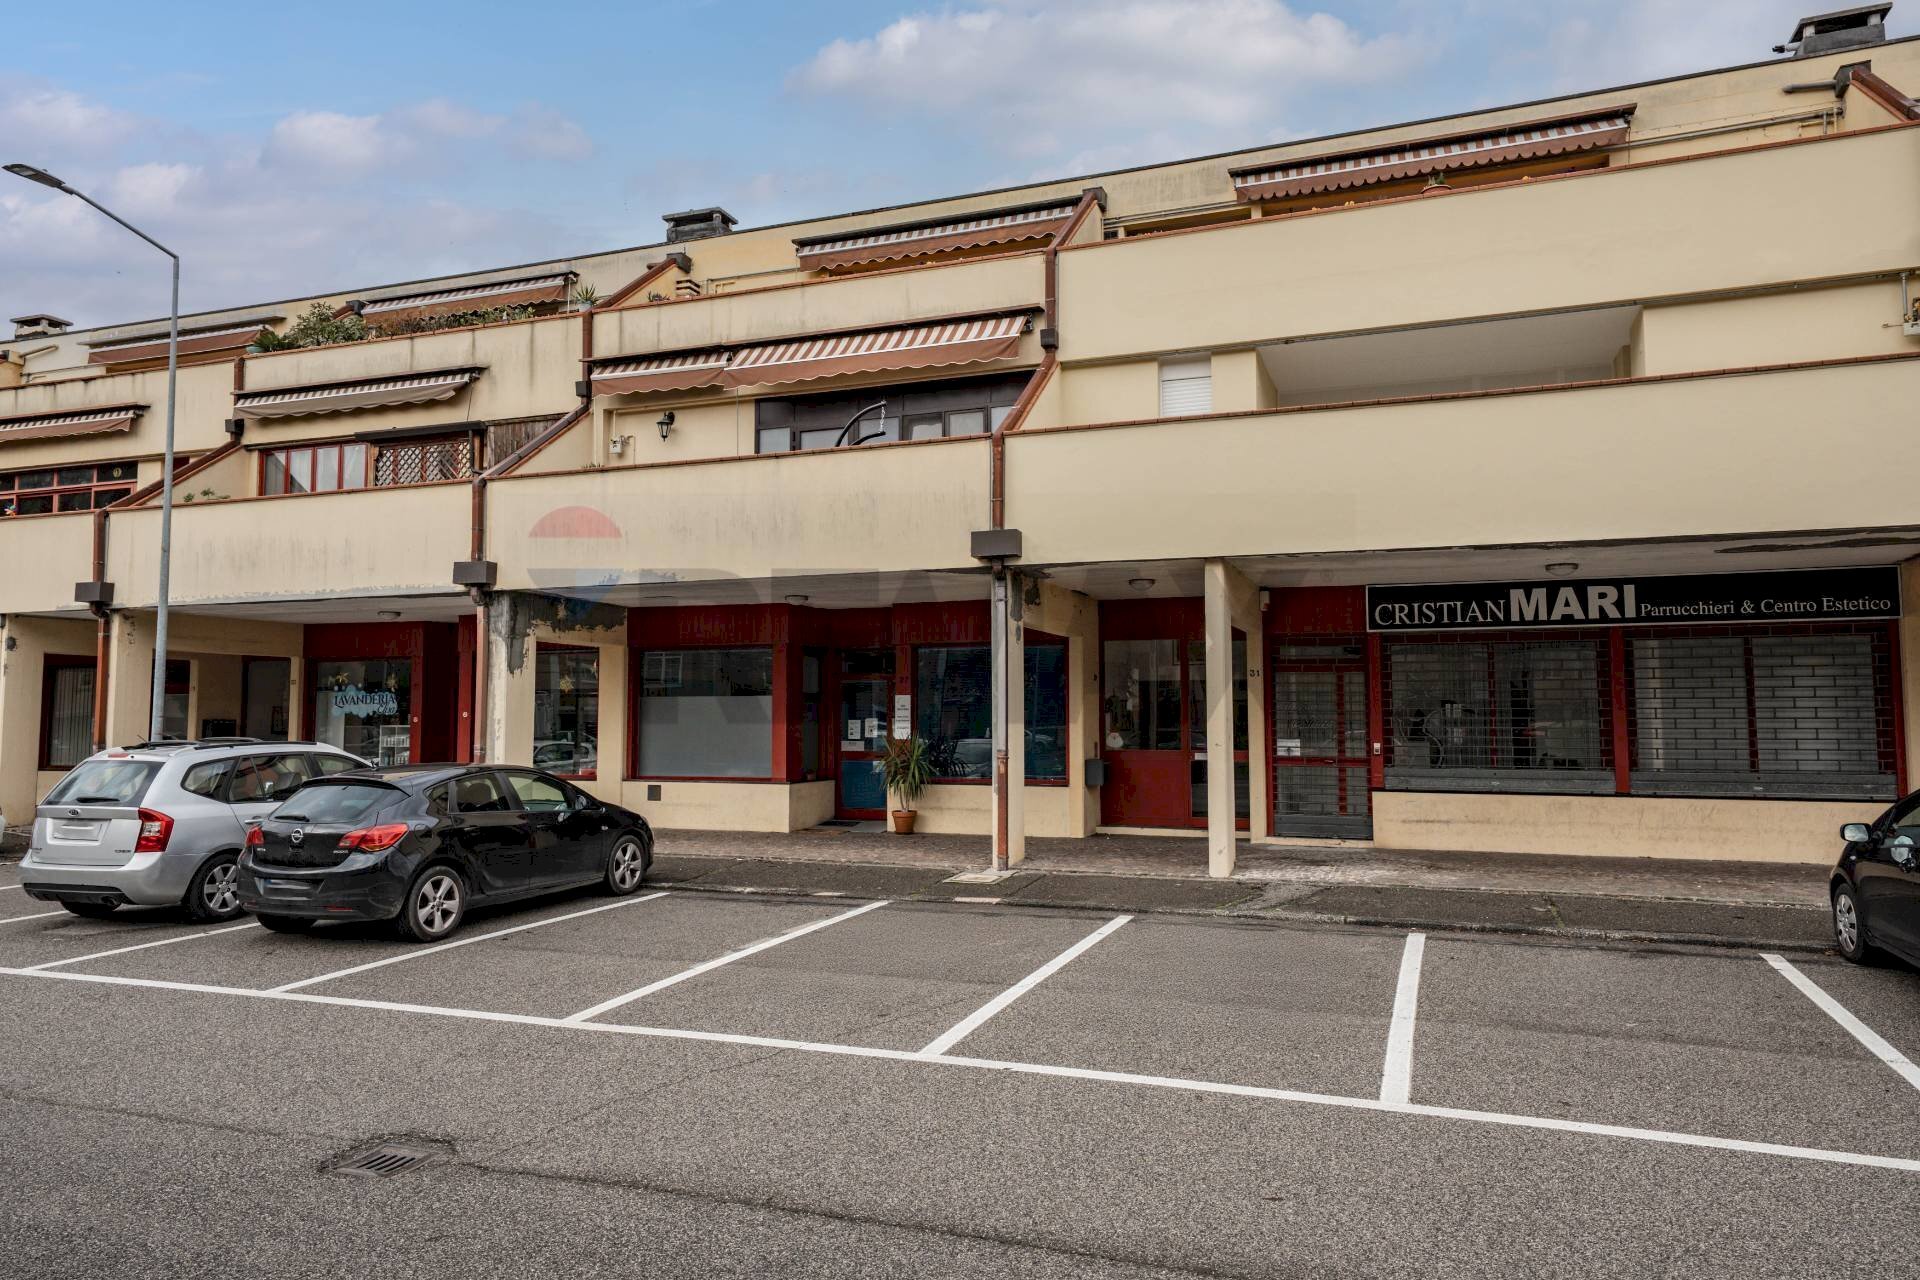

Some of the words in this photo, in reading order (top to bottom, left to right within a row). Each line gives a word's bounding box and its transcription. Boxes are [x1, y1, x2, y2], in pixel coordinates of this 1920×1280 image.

[1374, 600, 1506, 626] CRISTIAN
[1509, 585, 1637, 622] MARI
[1640, 601, 1735, 617] Parrucchieri
[1740, 599, 1755, 614] &
[1760, 599, 1817, 613] Centro
[1821, 596, 1891, 611] Estetico
[334, 693, 395, 708] LAVANDERIA
